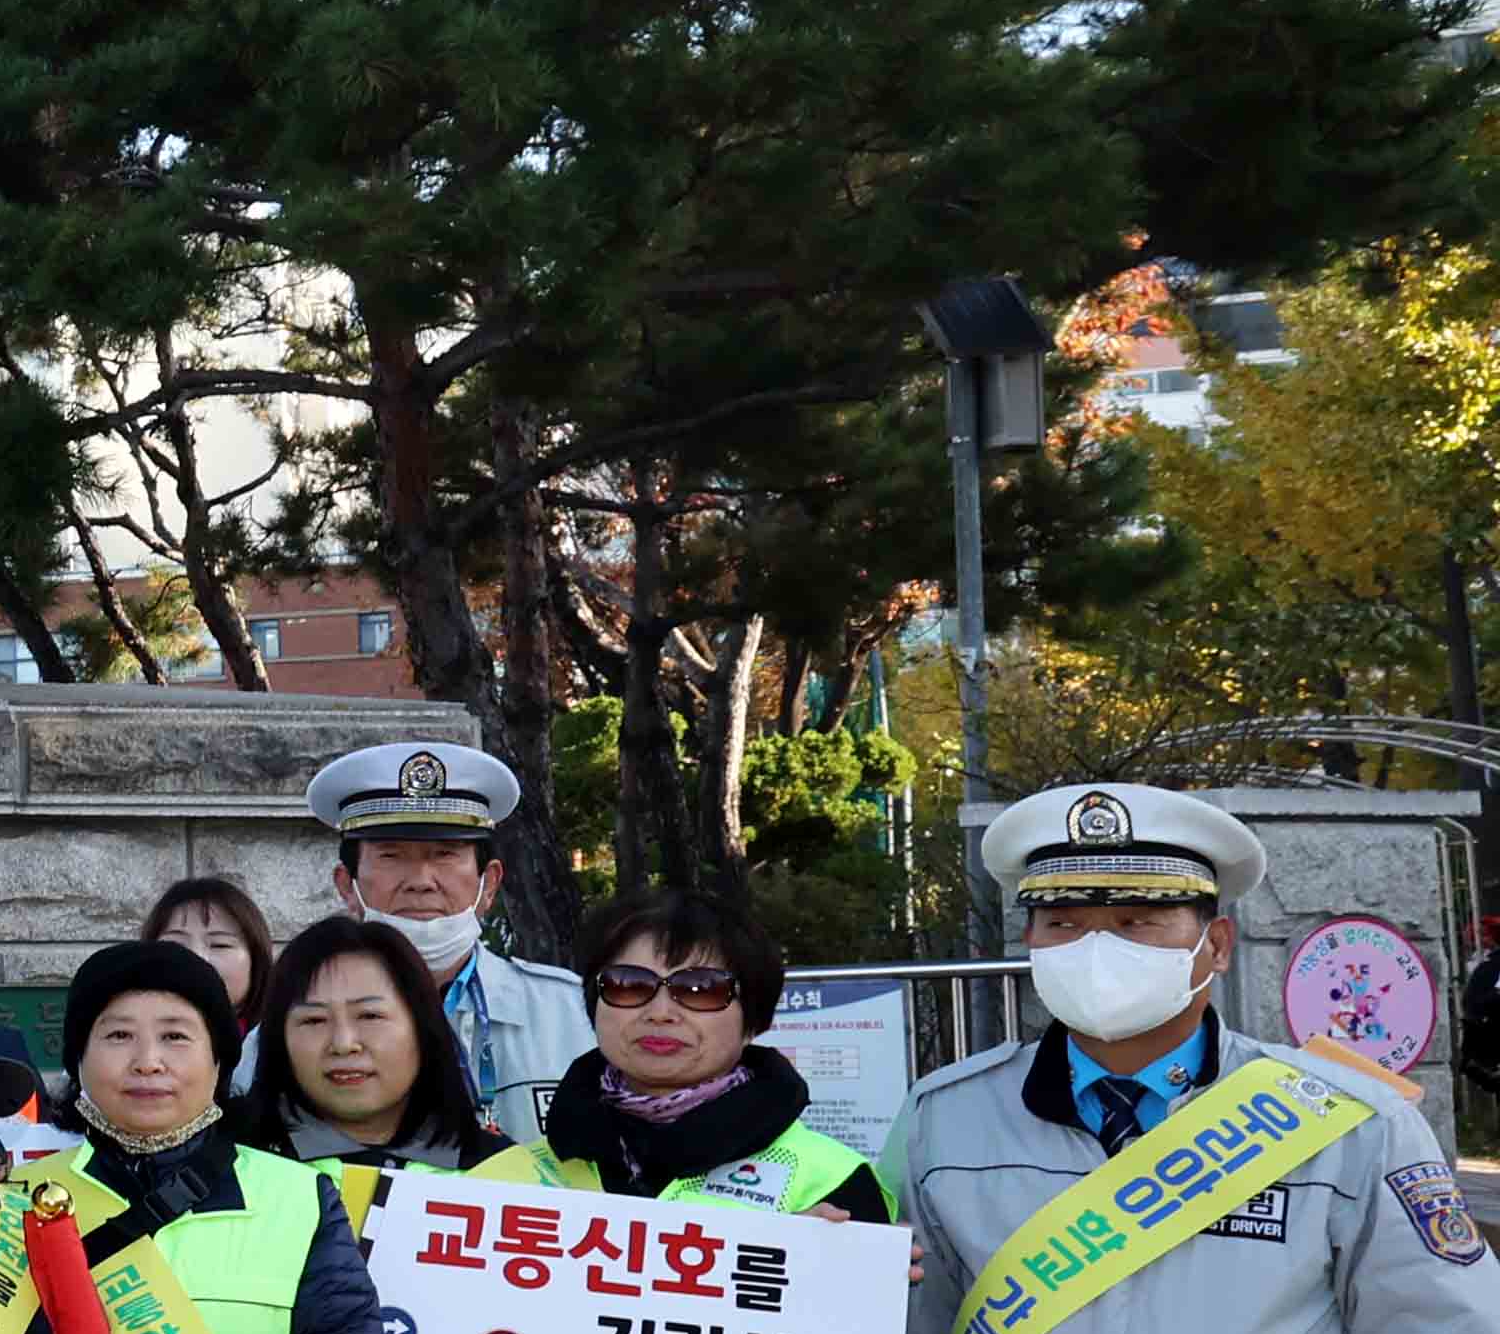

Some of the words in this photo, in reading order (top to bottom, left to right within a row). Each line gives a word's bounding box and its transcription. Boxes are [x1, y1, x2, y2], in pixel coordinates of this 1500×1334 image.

[1113, 1091, 1302, 1230] 우리아이
[416, 1199, 790, 1314] 교통신호를
[1021, 1208, 1128, 1292] 학교
[1230, 1219, 1282, 1237] DRIVER
